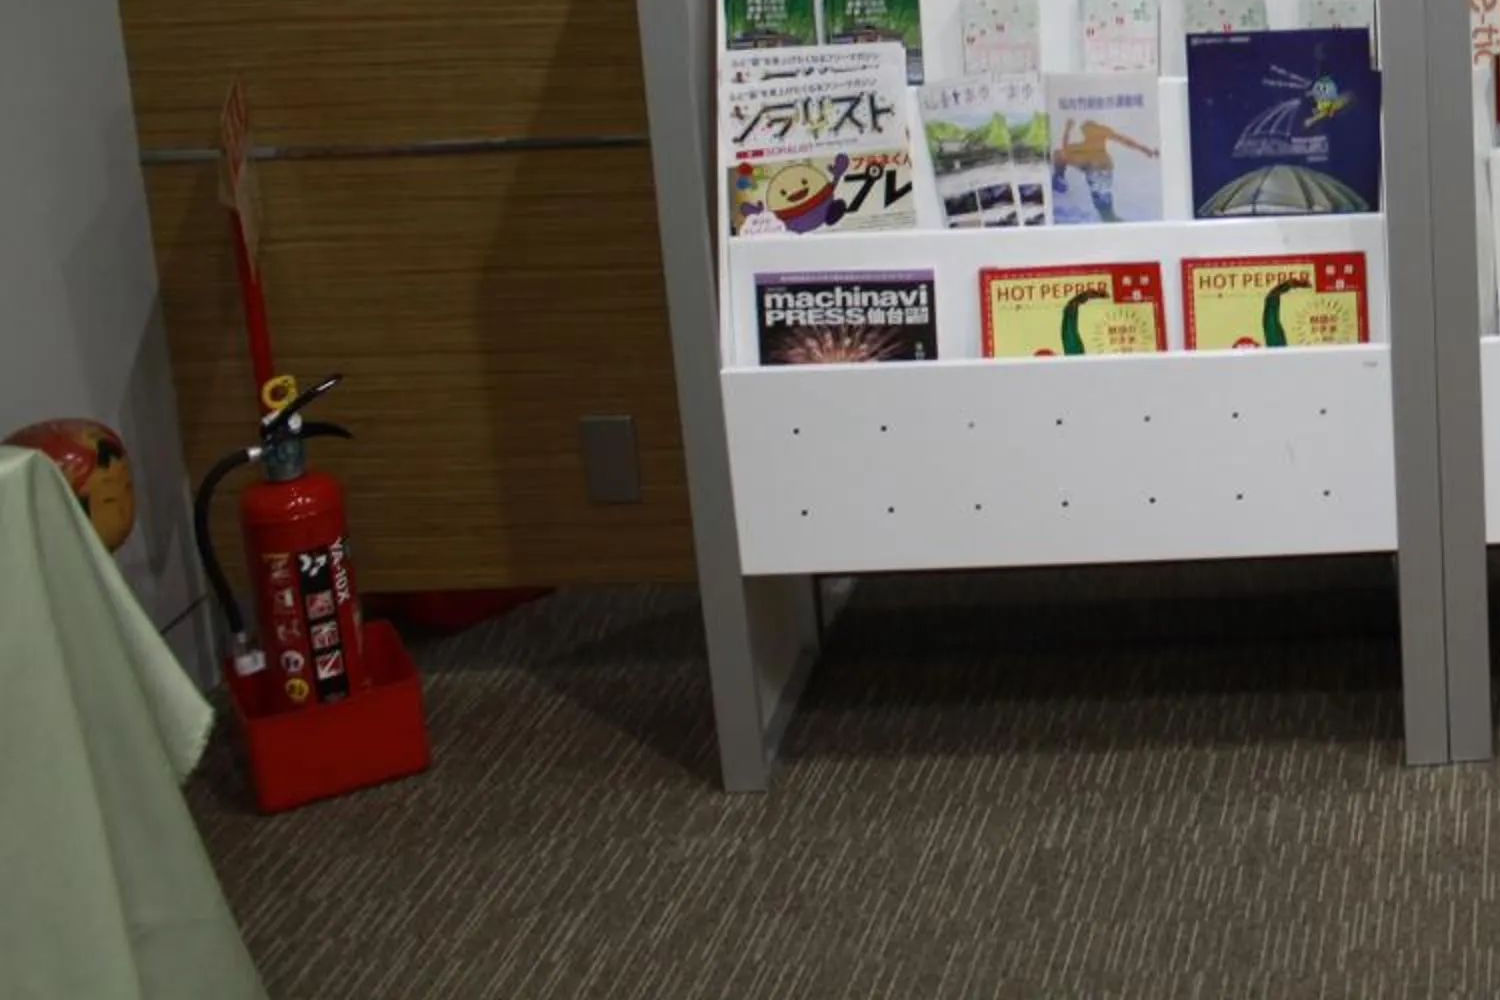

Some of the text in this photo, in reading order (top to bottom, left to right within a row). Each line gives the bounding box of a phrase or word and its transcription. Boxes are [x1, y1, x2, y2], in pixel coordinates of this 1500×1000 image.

[1199, 273, 1237, 289] HOT
[764, 284, 928, 310] machinavi
[997, 285, 1034, 301] HOT
[765, 307, 866, 327] PRESS
